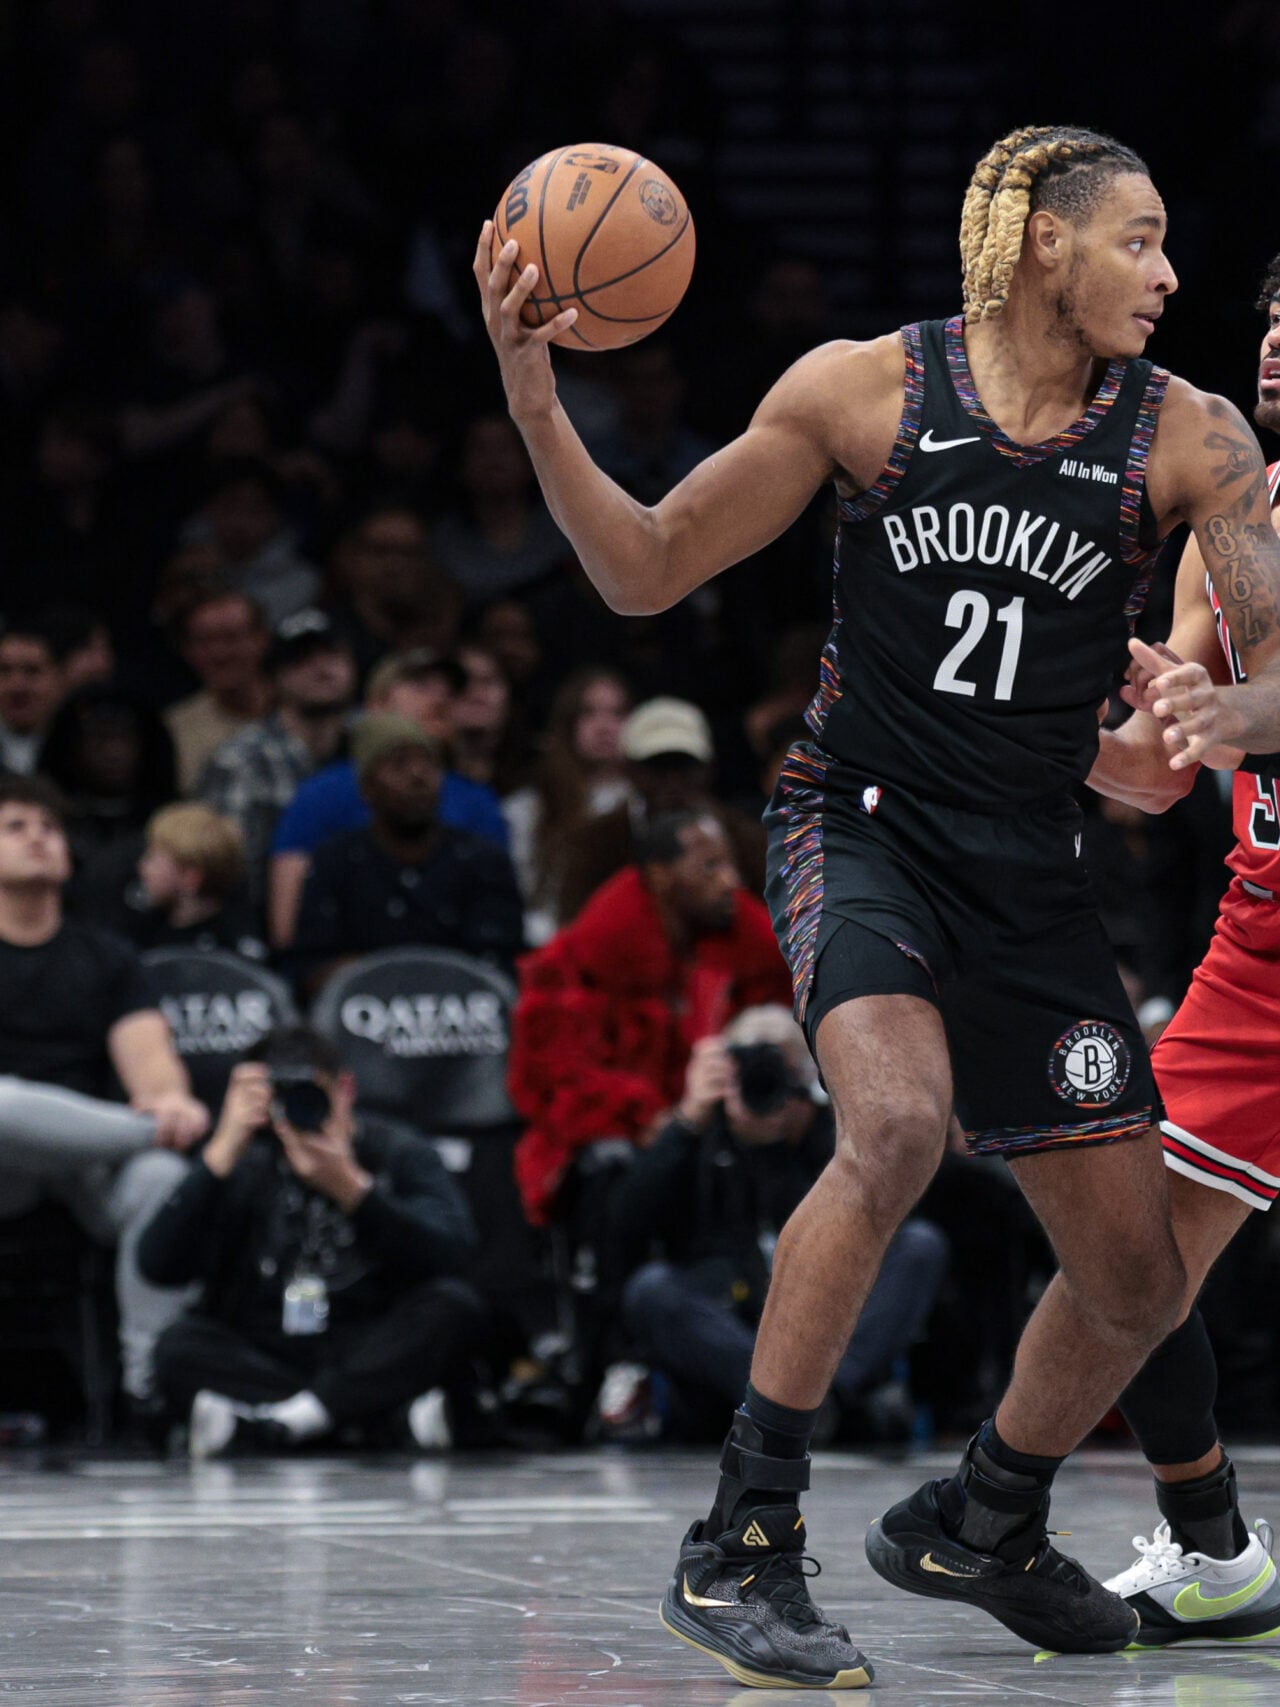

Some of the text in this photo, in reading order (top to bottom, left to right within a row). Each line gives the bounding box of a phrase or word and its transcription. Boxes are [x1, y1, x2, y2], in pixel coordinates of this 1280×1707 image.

[1059, 458, 1118, 485] All In Won
[882, 502, 1113, 601] BROOKLYN
[933, 589, 1025, 701] 21
[158, 991, 271, 1038] ATAR
[1058, 1025, 1120, 1056] BROOKLYN
[1083, 1044, 1101, 1085] B
[1060, 1077, 1122, 1102] NEW YORK
